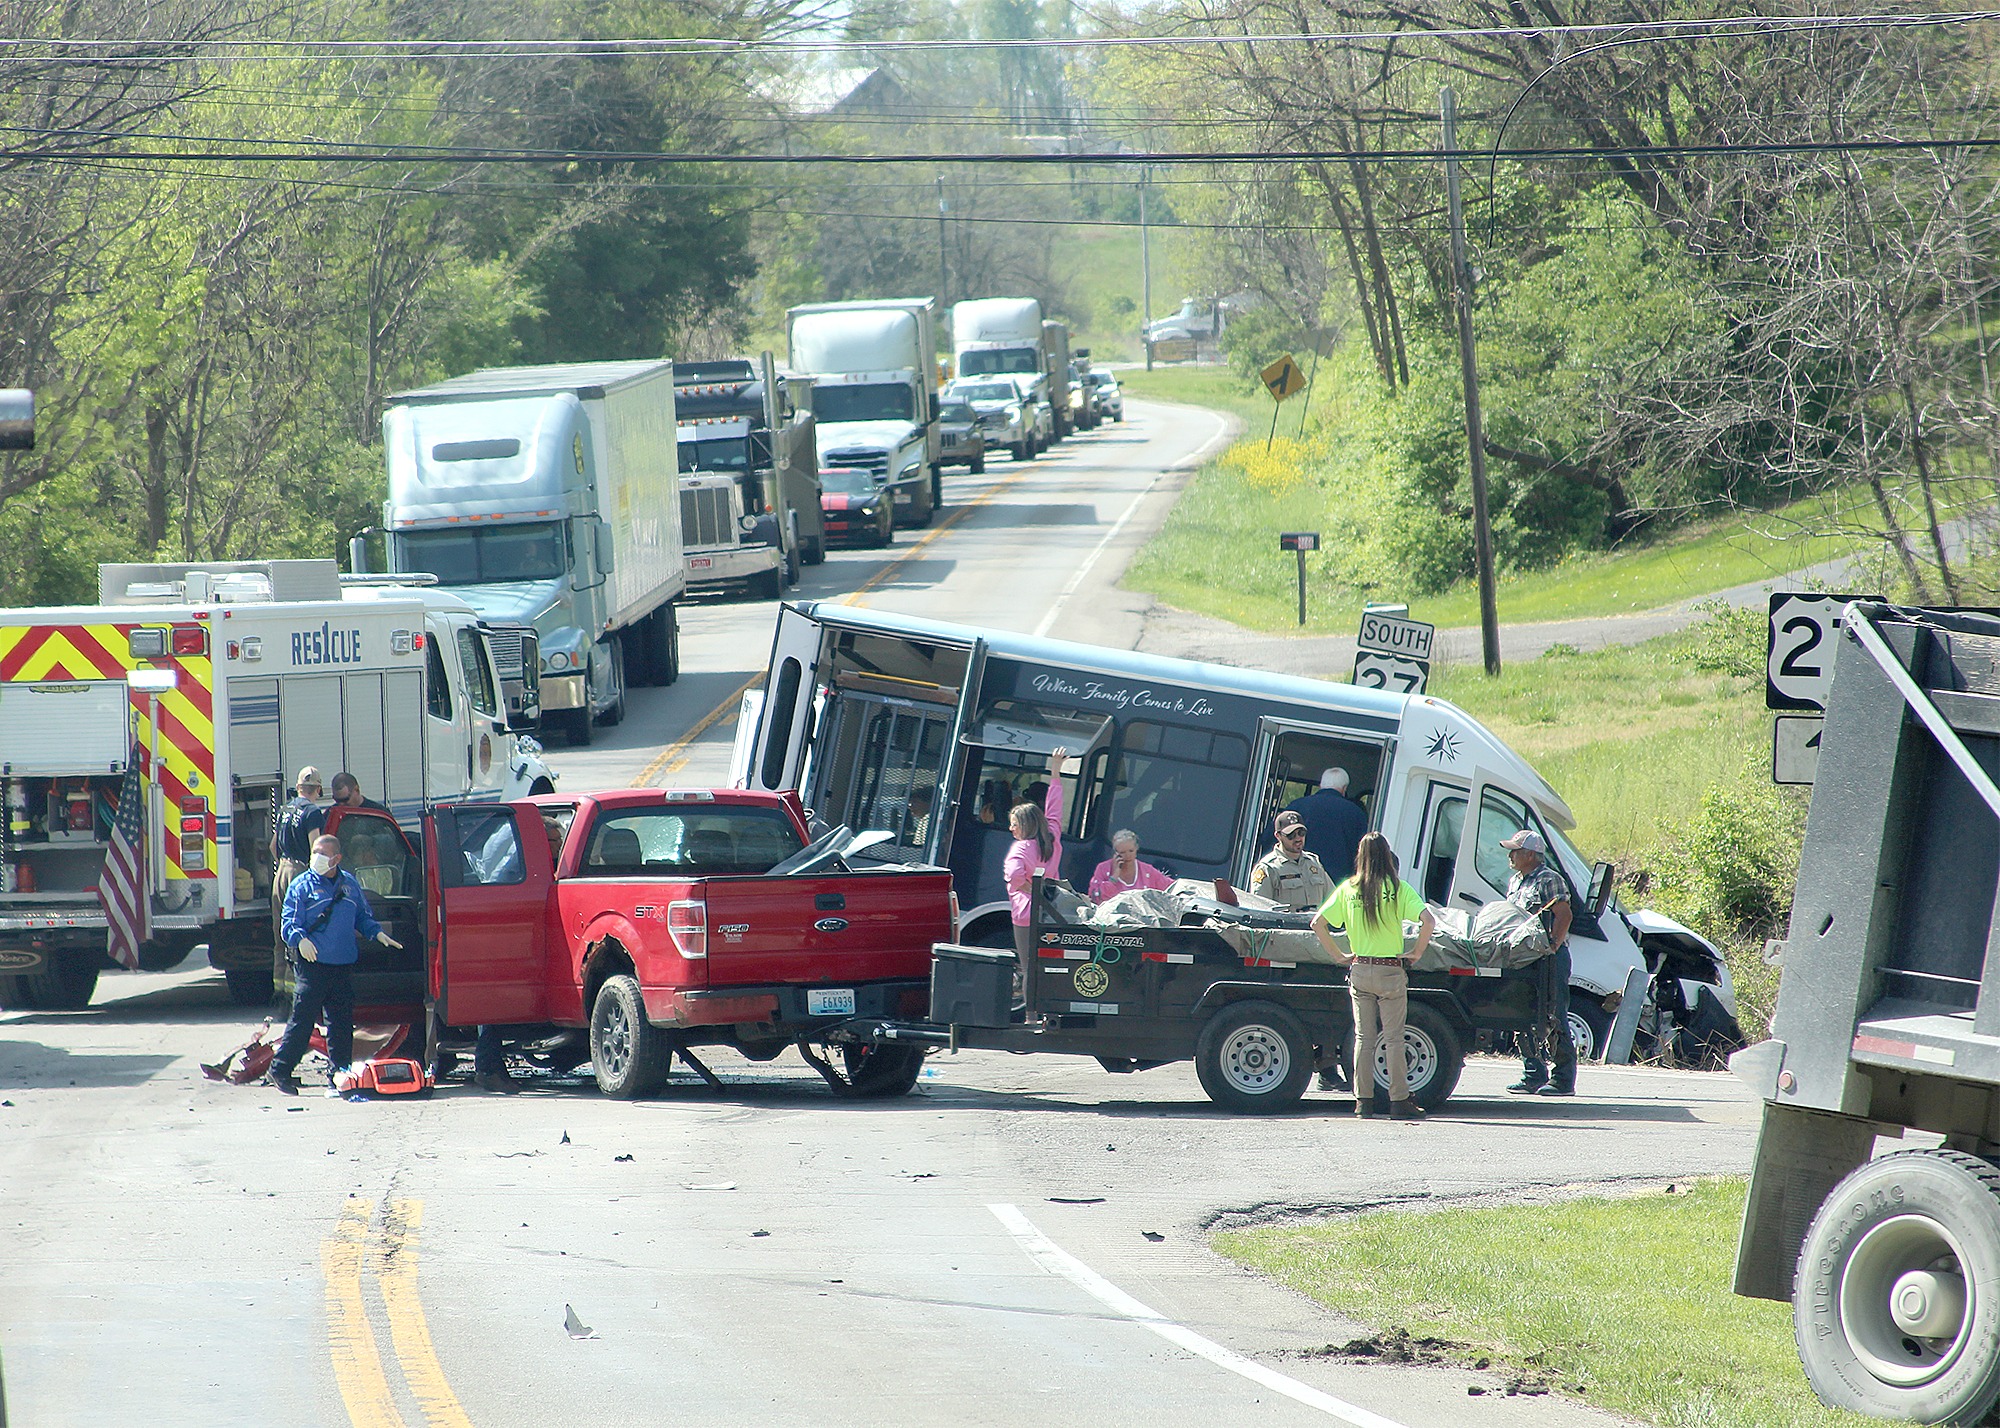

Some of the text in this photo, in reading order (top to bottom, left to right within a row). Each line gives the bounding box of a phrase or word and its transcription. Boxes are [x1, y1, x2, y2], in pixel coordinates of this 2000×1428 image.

[1363, 619, 1430, 652] SOUTH
[1779, 615, 1842, 678] 2
[1032, 673, 1215, 717] Where Family Comes to Live
[1361, 667, 1420, 694] 27
[634, 905, 665, 919] STX
[1060, 933, 1145, 948] BYPASS RENTAL
[822, 996, 853, 1009] E6X939
[1813, 1184, 1905, 1341] Firestone
